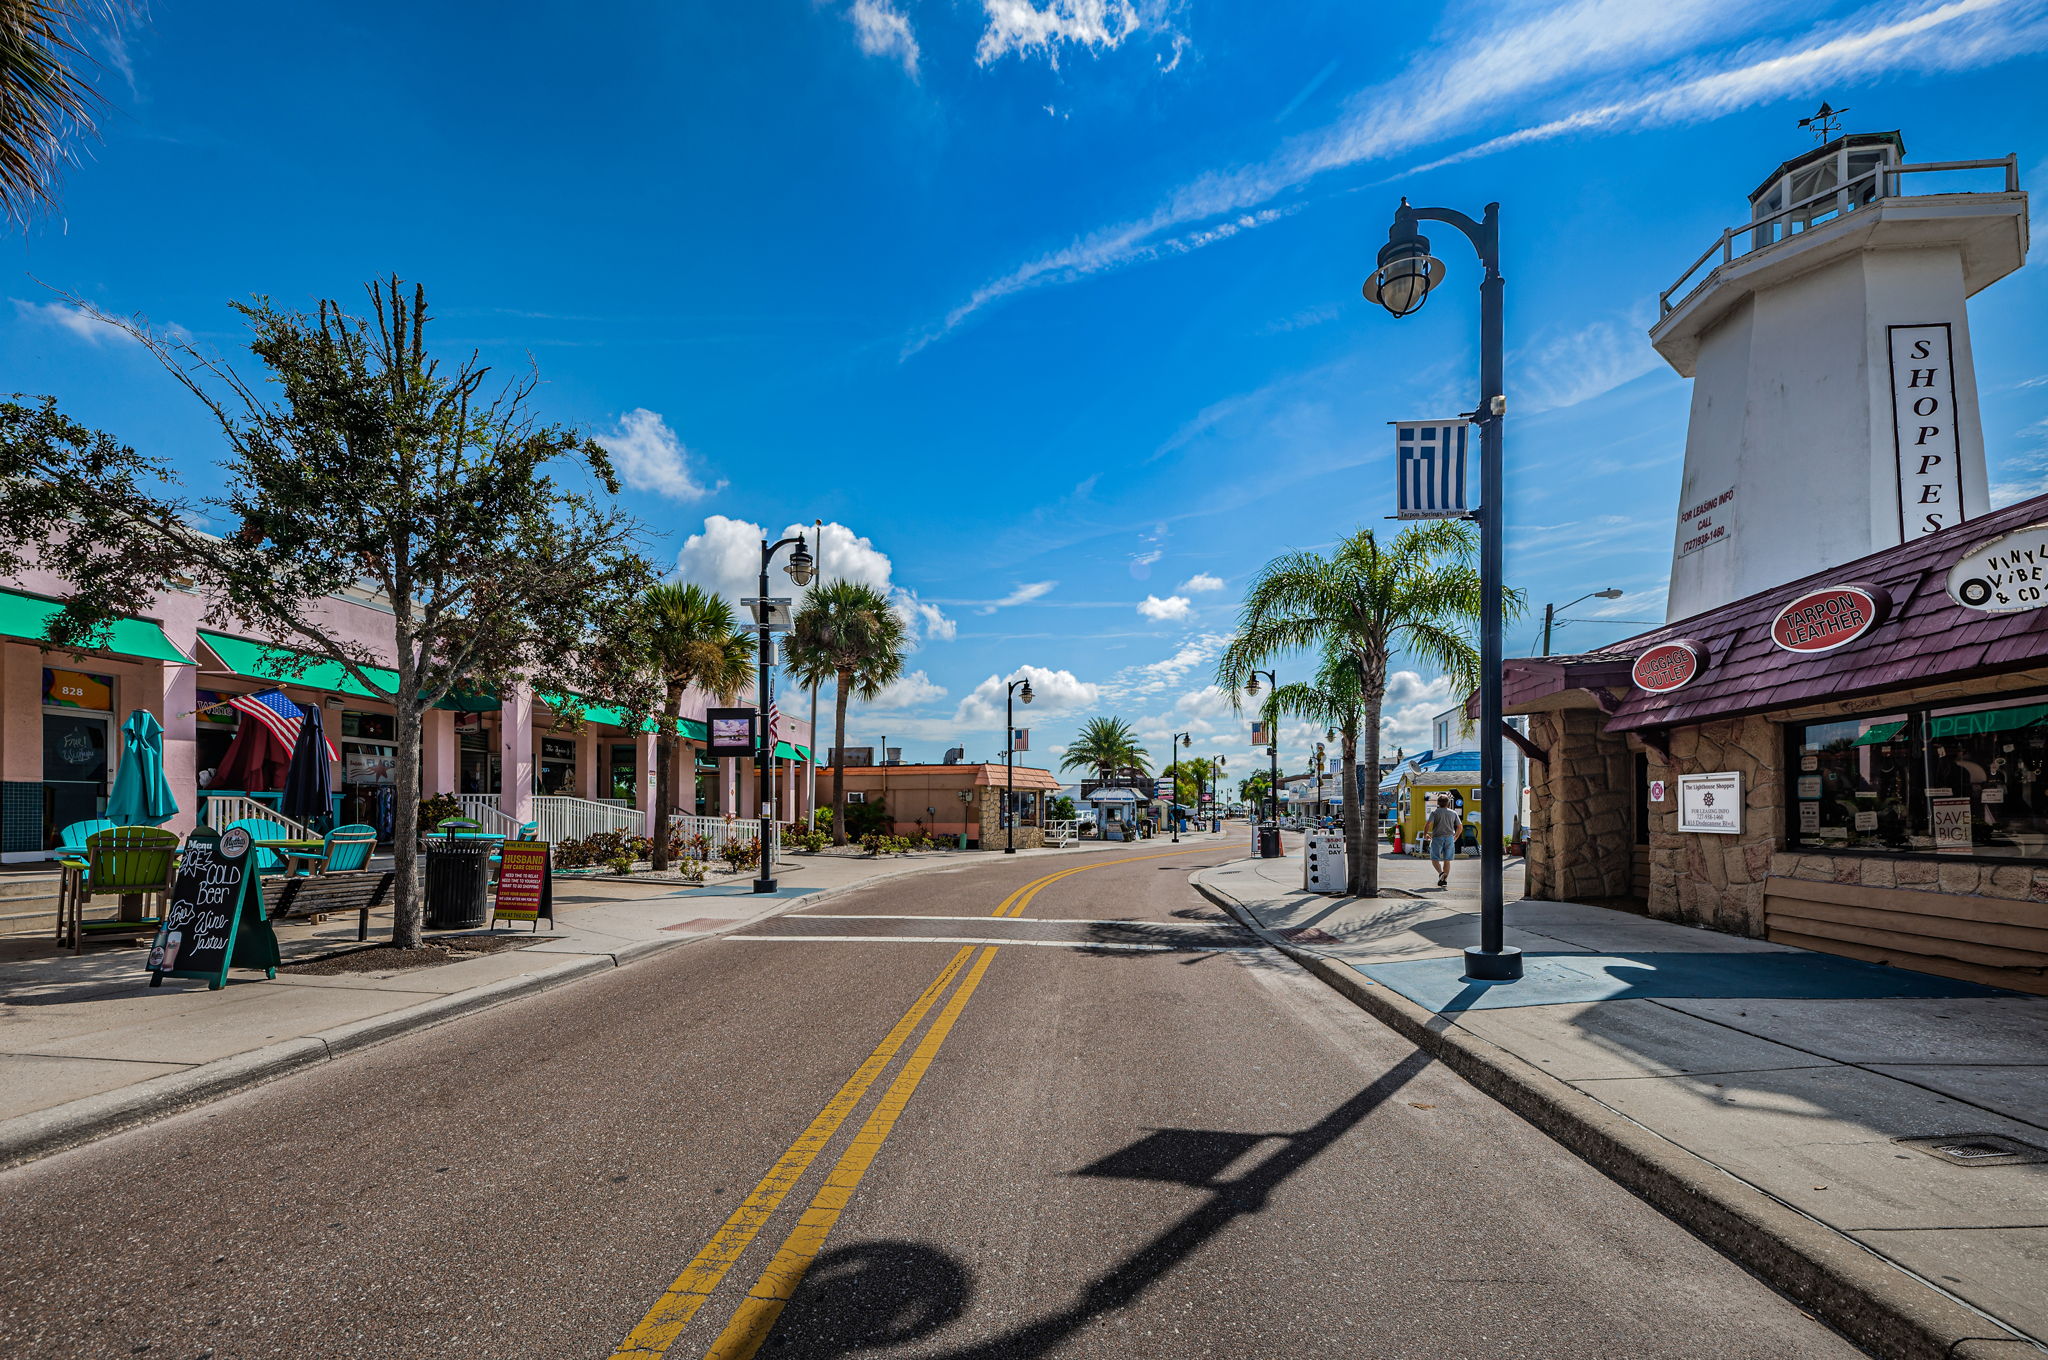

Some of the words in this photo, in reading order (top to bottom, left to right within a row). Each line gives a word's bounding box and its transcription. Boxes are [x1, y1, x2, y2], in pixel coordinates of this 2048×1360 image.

[1907, 340, 1943, 533] SHOPPES
[1681, 511, 1692, 524] FOR
[1693, 498, 1717, 518] LEASING
[1718, 490, 1734, 505] INFO
[1698, 517, 1712, 530] CALL
[1684, 526, 1725, 554] (727)938-1460
[1987, 544, 2048, 570] VINYL
[1996, 592, 2010, 604] &
[1783, 592, 1856, 629] TARPON
[1786, 609, 1866, 646] LEATHER
[1636, 650, 1689, 677] LUGGAGE
[1646, 664, 1687, 688] OUTLET
[62, 687, 84, 696] 828
[197, 700, 232, 716] Wine
[1920, 712, 1994, 742] OPEN
[1693, 783, 1715, 791] Lighthouse
[1716, 782, 1734, 790] Shoppes
[1936, 811, 1970, 825] SAVE
[188, 840, 212, 850] Menu
[1939, 828, 1968, 841] BIG!
[188, 851, 204, 866] ICE
[504, 854, 544, 864] HUSBAND
[206, 864, 240, 885] COLD
[196, 880, 230, 905] Beer
[194, 910, 228, 934] Wine
[190, 932, 228, 956] Tastes
